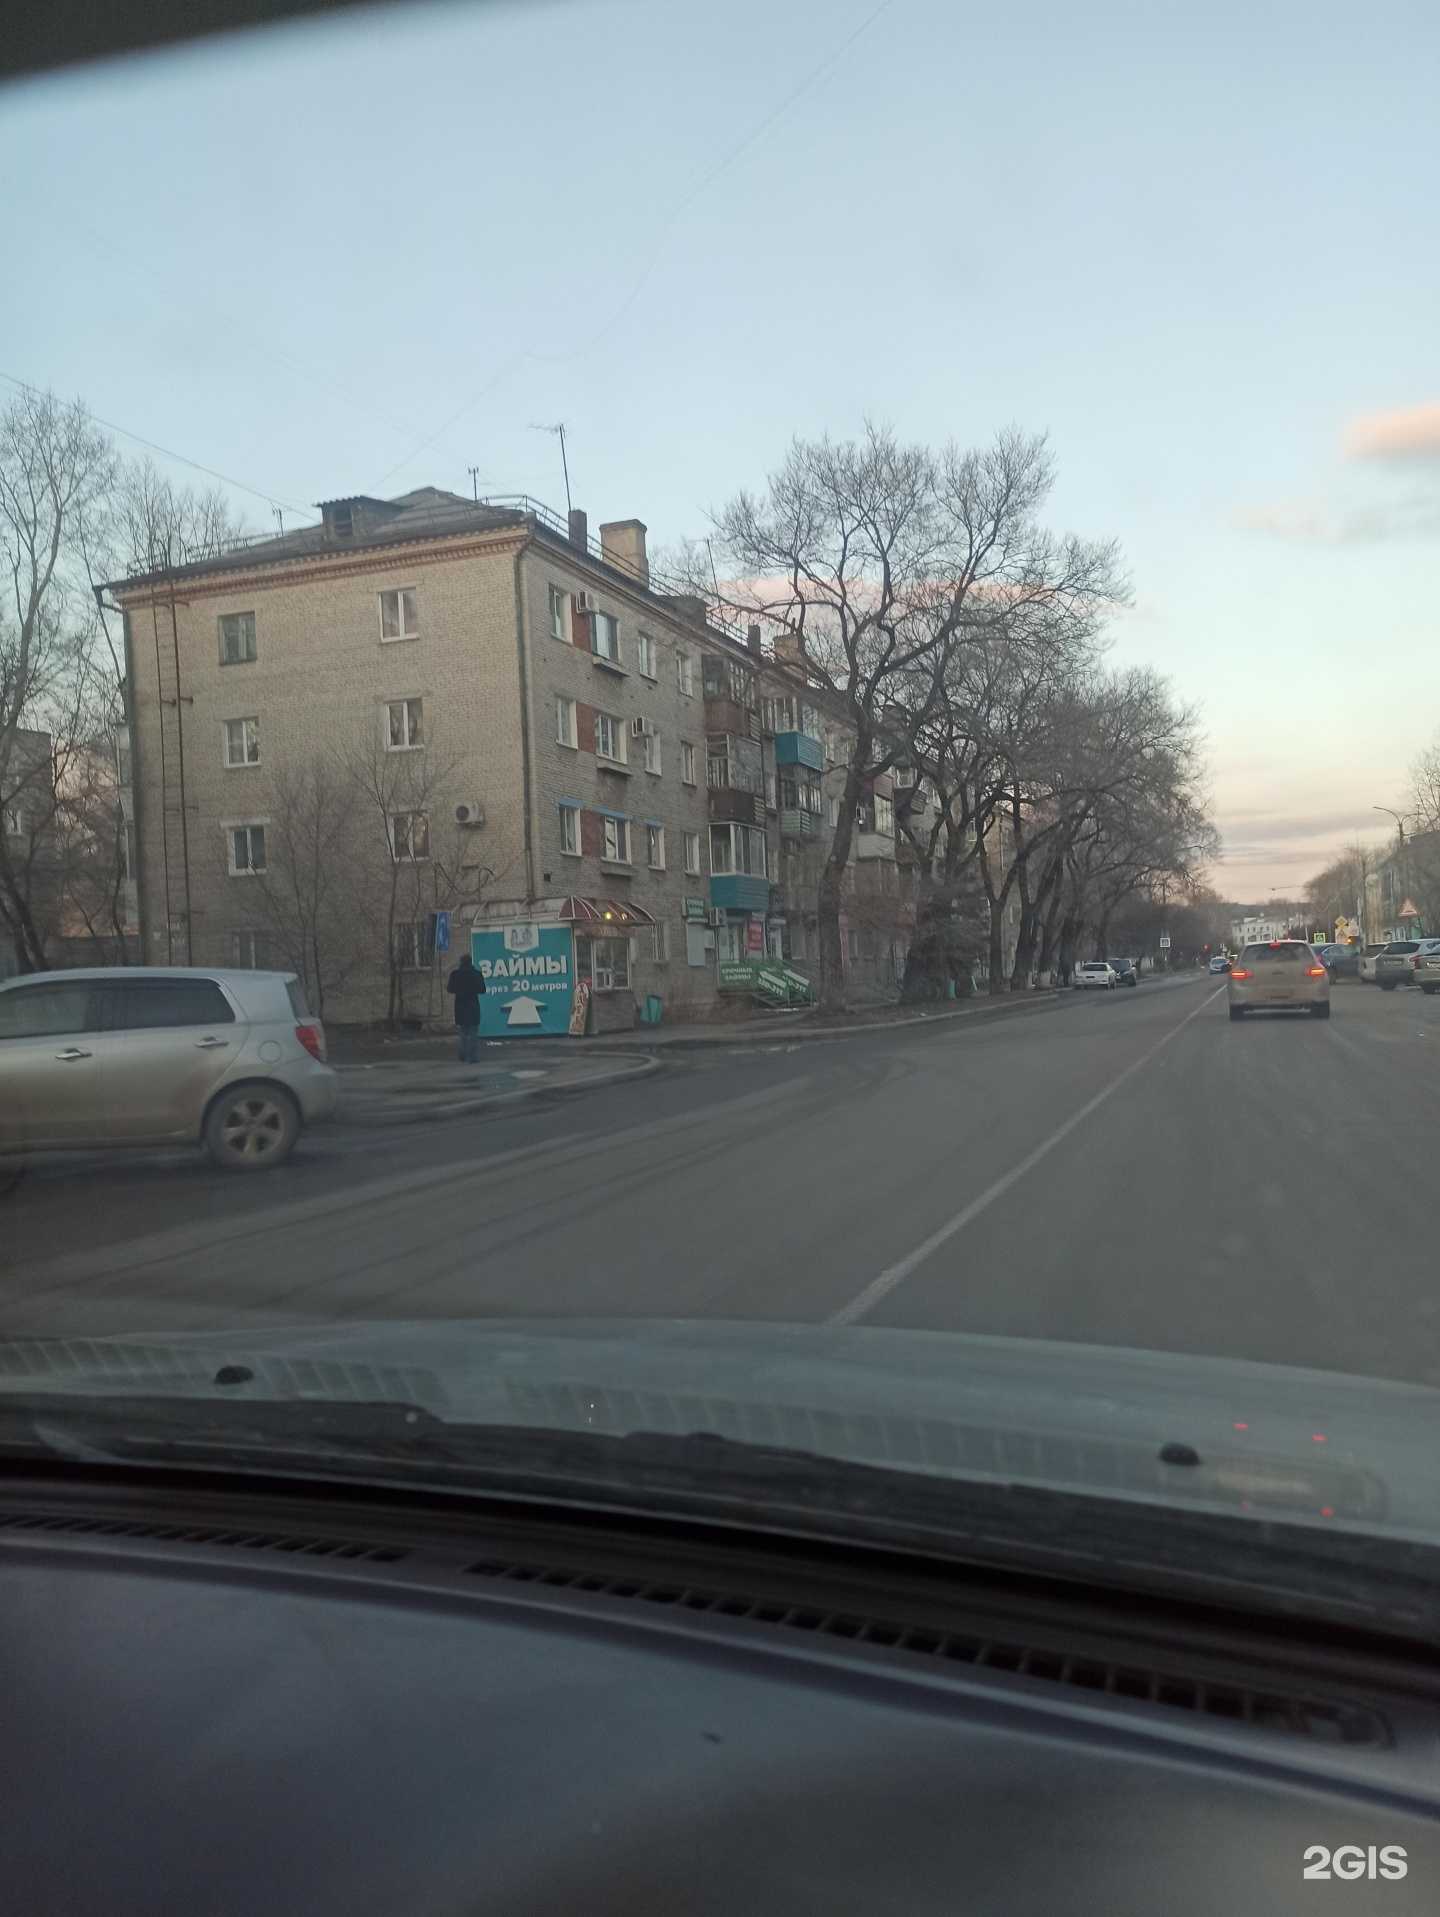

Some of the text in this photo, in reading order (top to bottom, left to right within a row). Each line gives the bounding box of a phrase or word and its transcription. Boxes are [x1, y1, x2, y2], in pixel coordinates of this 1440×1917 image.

[479, 954, 567, 978] ЗАЙМЫ
[486, 979, 568, 996] ерез 20 метров
